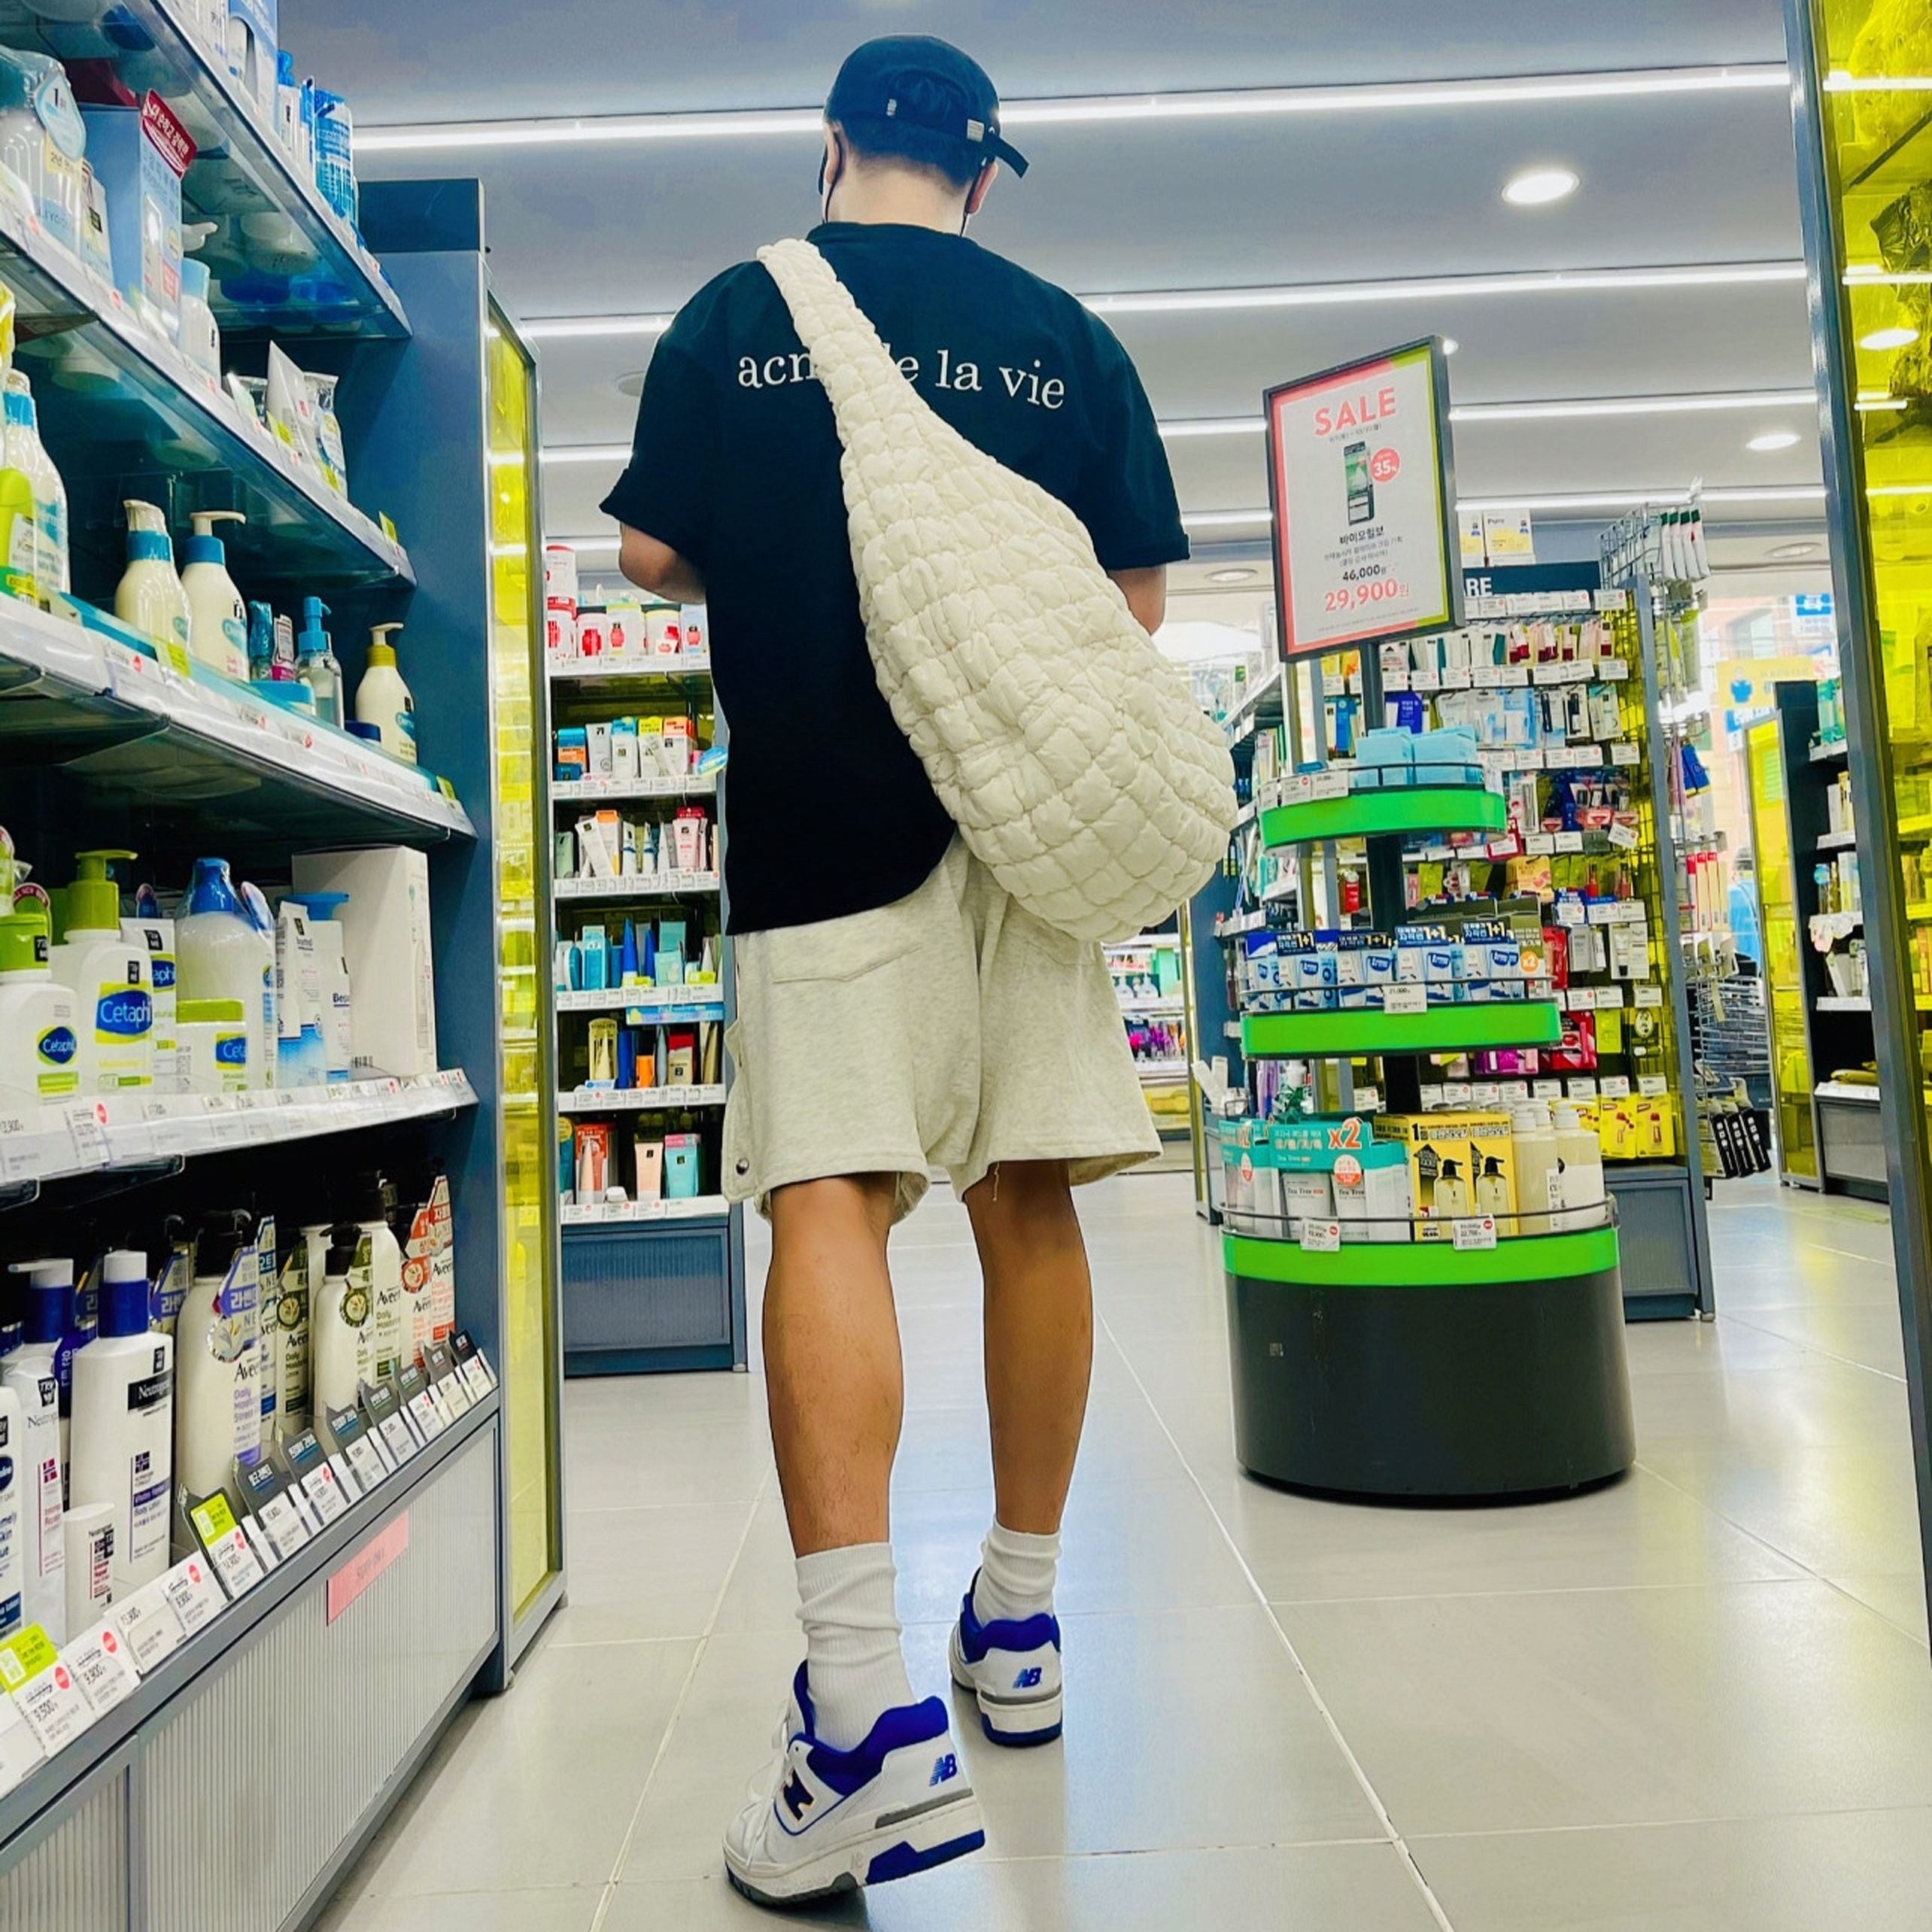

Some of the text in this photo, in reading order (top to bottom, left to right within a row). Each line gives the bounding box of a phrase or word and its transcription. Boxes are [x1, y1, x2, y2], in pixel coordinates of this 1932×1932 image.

[935, 349, 983, 392] la
[998, 360, 1065, 409] vie
[1314, 387, 1396, 436] SALE
[1324, 578, 1410, 612] 29,900원
[1463, 576, 1493, 598] RE
[1423, 925, 1445, 940] 1+1
[1487, 921, 1505, 937] 1+1
[100, 1001, 151, 1029] Cetaphi
[223, 1041, 246, 1059] Ceta
[1326, 1117, 1362, 1150] x2
